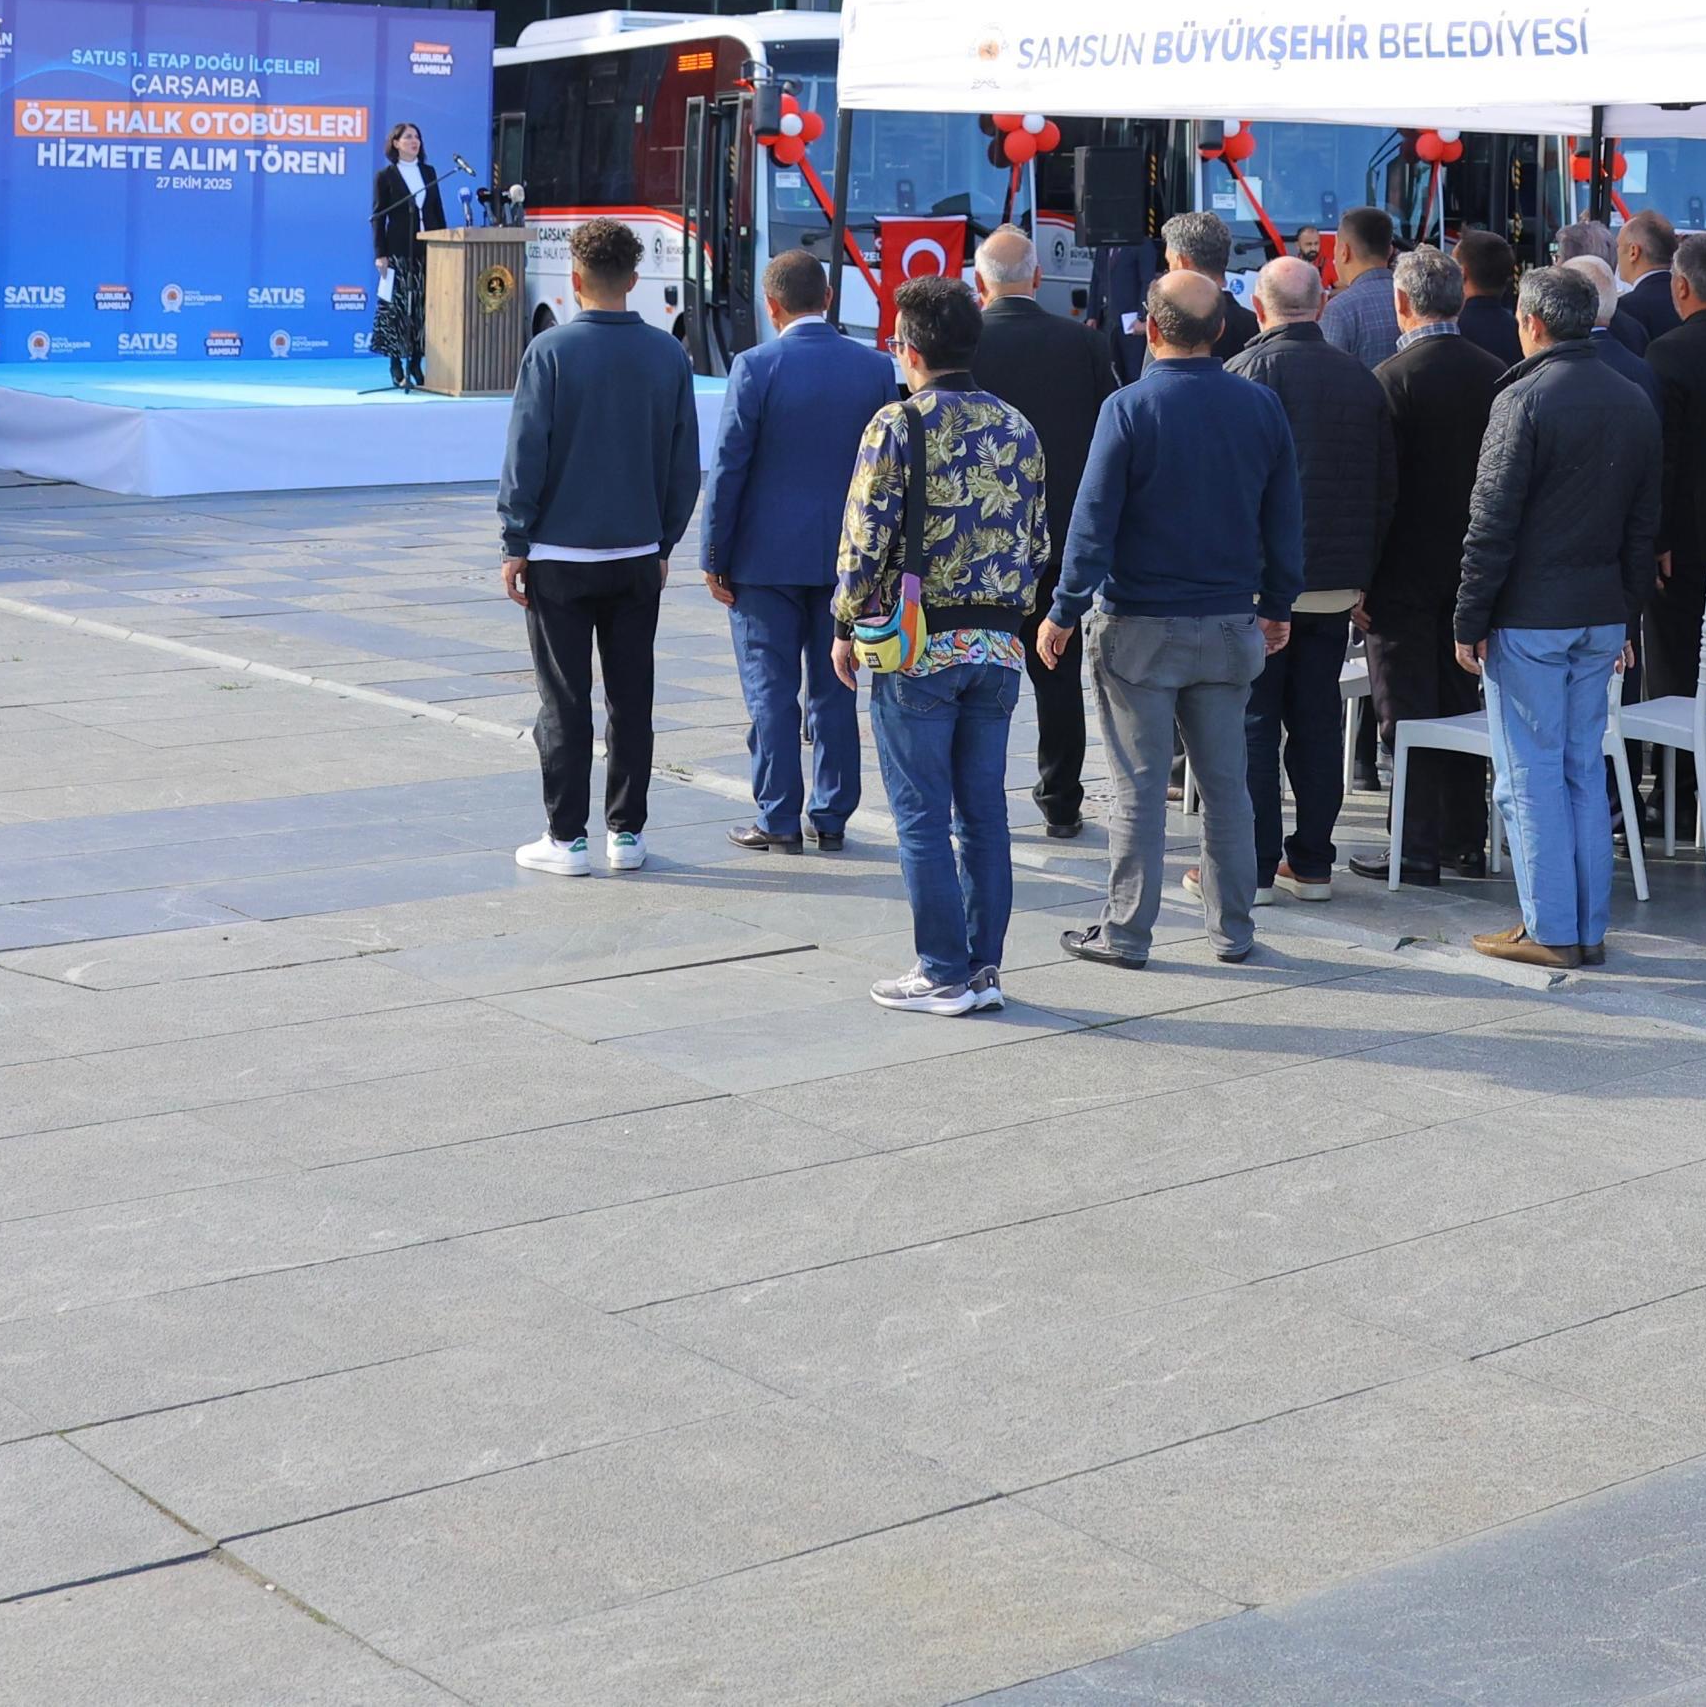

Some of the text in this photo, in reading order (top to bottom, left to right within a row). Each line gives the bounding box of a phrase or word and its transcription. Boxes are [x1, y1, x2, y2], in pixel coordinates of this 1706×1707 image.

[1016, 7, 1590, 70] SAMSUN BÜYÜKŞEHİR BELEDİYESİ
[71, 49, 320, 76] SATUS 1. ETAP DOĞU İLÇELERİ
[409, 52, 453, 65] GURURLA
[412, 63, 451, 75] SAMSUN
[131, 74, 261, 99] ÇARŞAMBA
[21, 102, 362, 138] ÖZEL HALK OTOBÜSLERİ
[37, 138, 345, 175] HİZMETE ALIM TÖRENİ
[156, 176, 232, 191] 27 EKİM 2025
[4, 285, 66, 304] SATUS
[248, 286, 306, 304] SATUS
[97, 301, 130, 310] SAMSUN
[118, 332, 178, 350] SATUS
